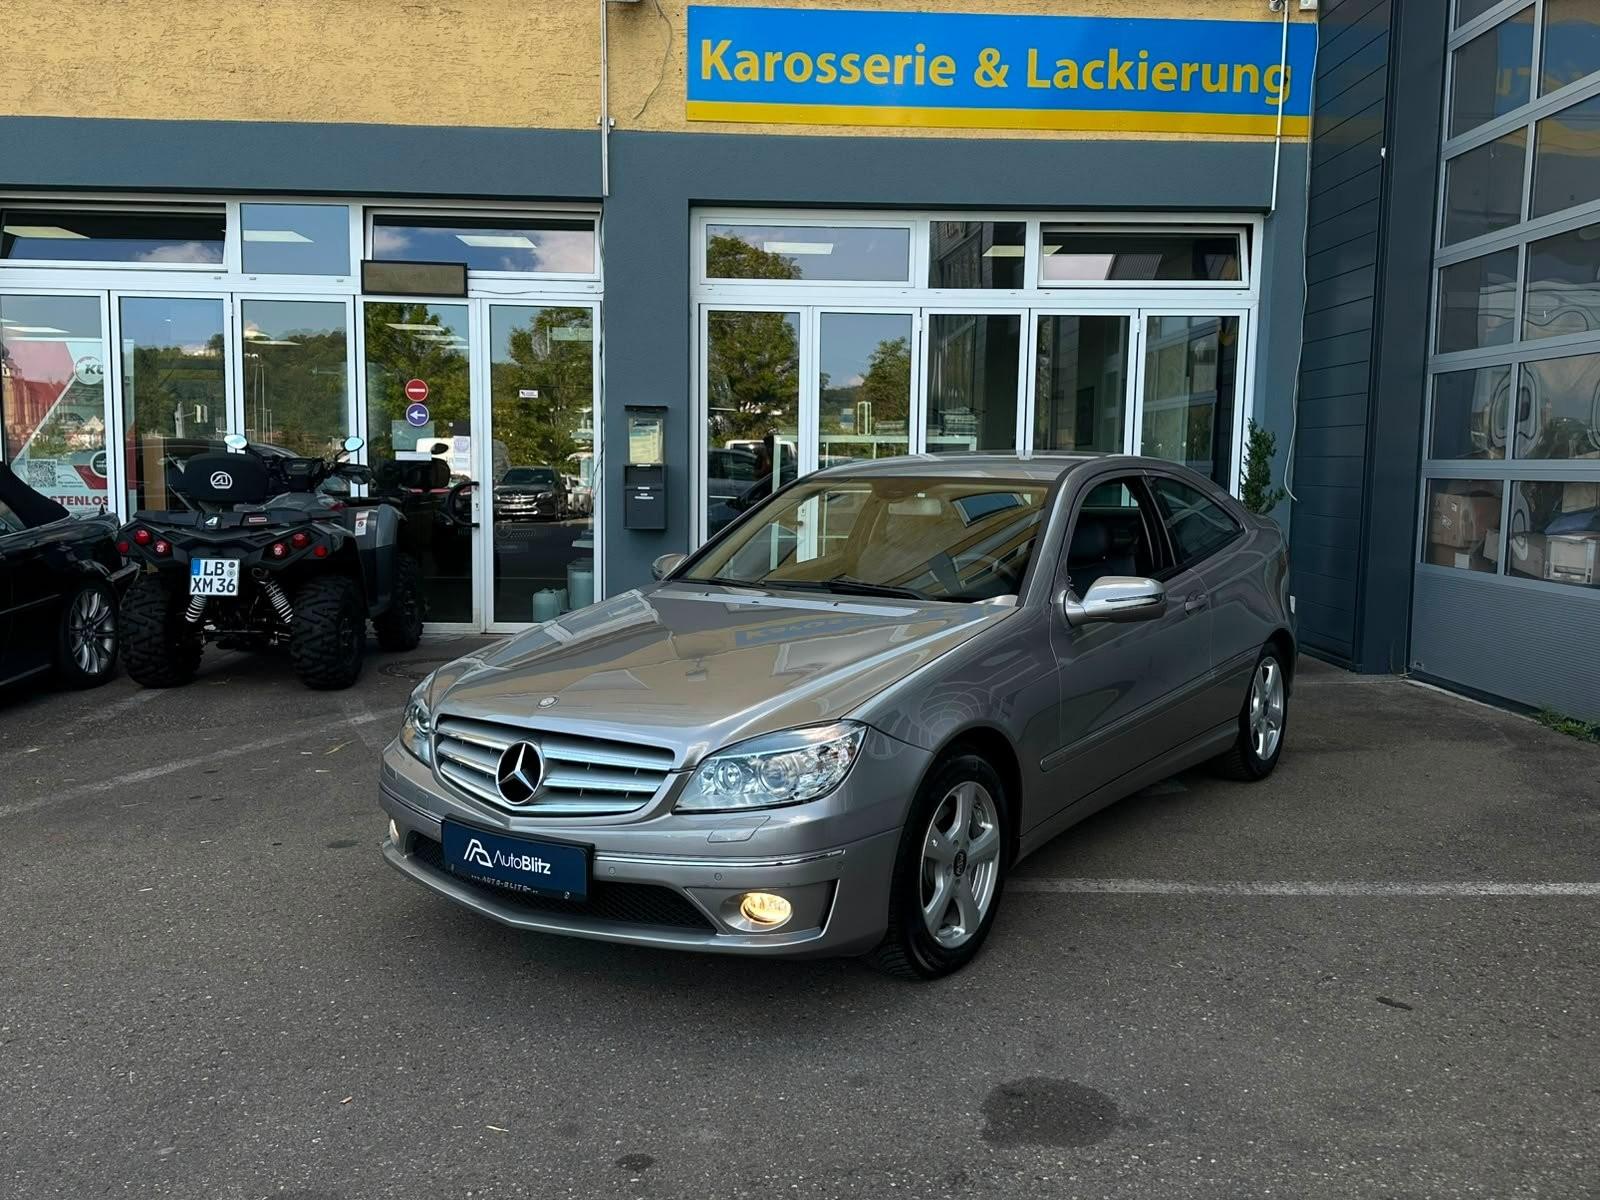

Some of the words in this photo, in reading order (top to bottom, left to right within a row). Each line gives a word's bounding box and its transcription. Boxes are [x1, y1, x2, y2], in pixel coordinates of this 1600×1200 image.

[700, 39, 956, 87] Karosserie
[974, 47, 1009, 89] &
[1027, 48, 1293, 106] Lackierung
[203, 561, 224, 576] LB
[192, 577, 213, 593] XM
[216, 578, 236, 593] 36
[494, 850, 551, 875] AutoBlitz
